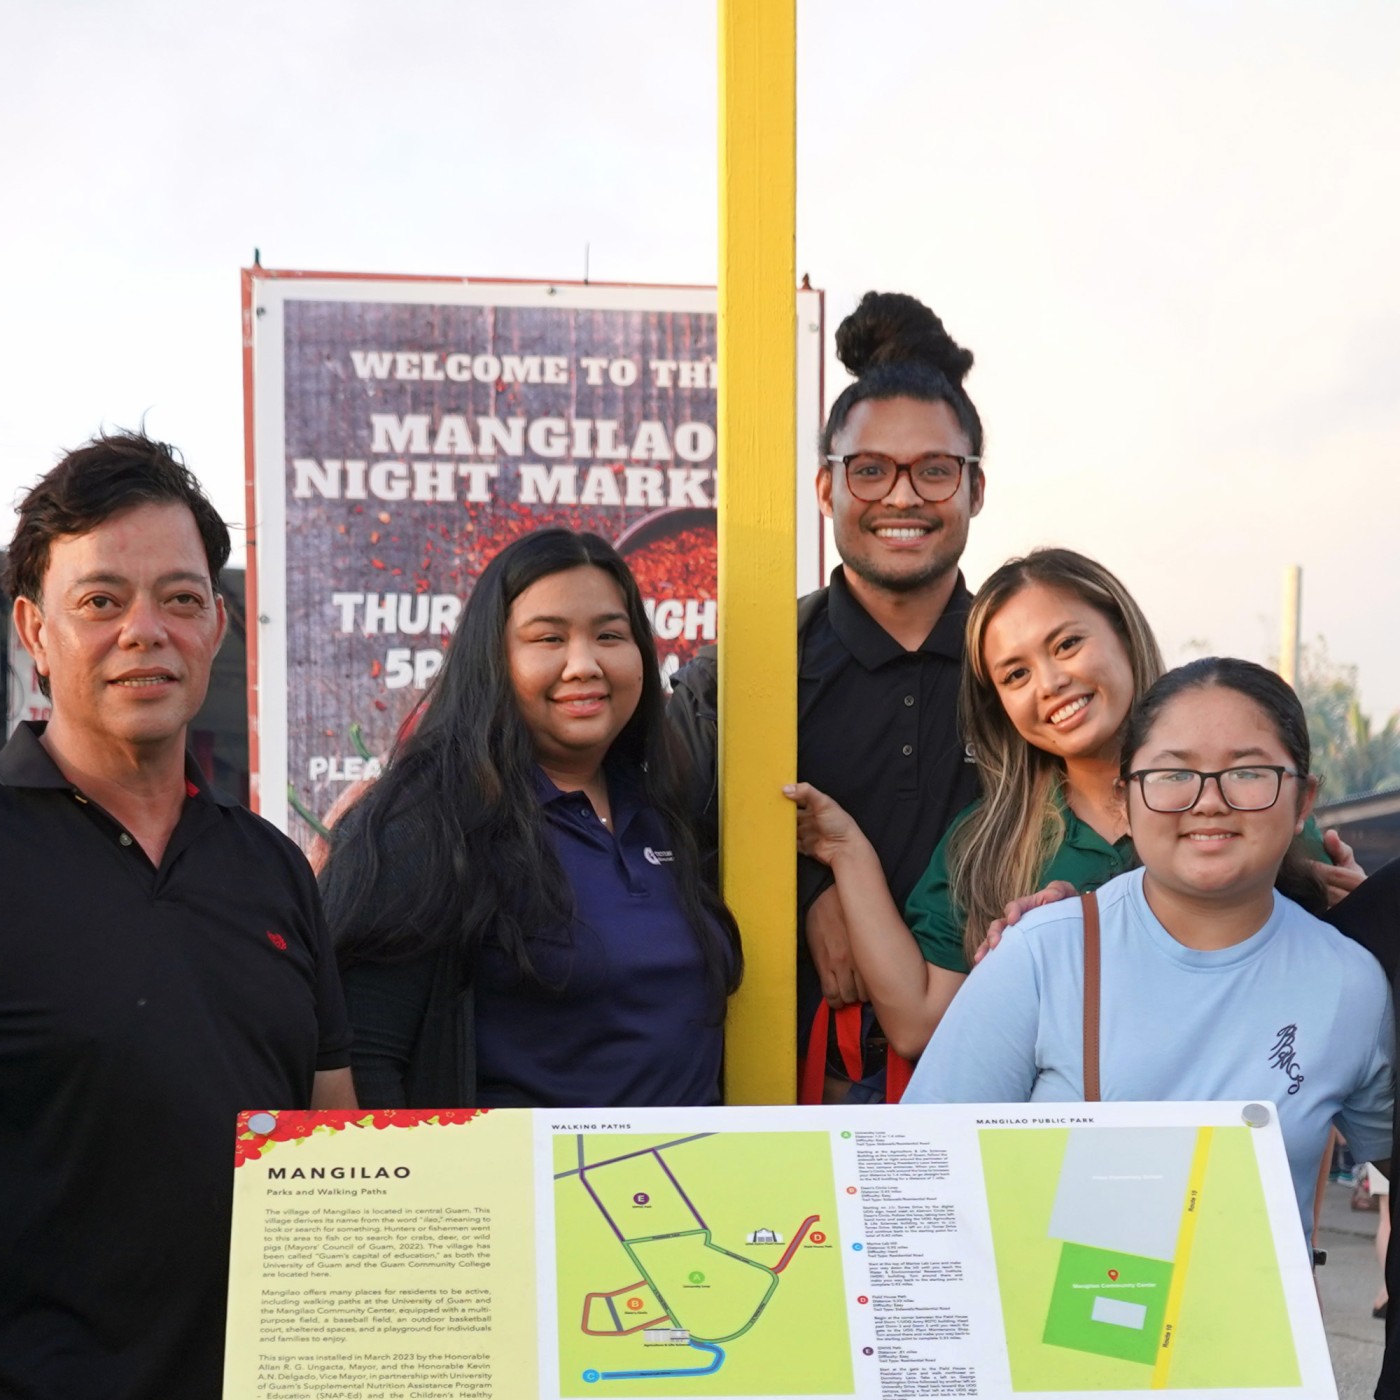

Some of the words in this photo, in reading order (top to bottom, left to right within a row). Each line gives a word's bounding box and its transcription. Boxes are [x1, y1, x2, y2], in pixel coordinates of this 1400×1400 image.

[351, 351, 569, 384] WELCOME
[581, 357, 638, 387] TO
[650, 359, 717, 389] TH
[370, 413, 717, 462] MANGILAO
[293, 459, 499, 502] NIGHT
[518, 463, 718, 509] MARK
[332, 592, 463, 636] THUR
[384, 648, 445, 690] 5P
[309, 756, 382, 781] PLEA
[268, 1166, 411, 1180] MANGILAO
[317, 1189, 358, 1197] Walking
[283, 1209, 310, 1217] village
[323, 1208, 361, 1217] Mangilao
[263, 1262, 303, 1270] University
[408, 1261, 456, 1270] Community
[458, 1261, 491, 1269] College
[261, 1290, 301, 1298] Mangilao
[355, 1289, 382, 1297] places
[278, 1355, 296, 1363] sign
[588, 1372, 594, 1380] C
[303, 1383, 365, 1391] Supplemental
[455, 1382, 493, 1390] Program
[316, 1392, 362, 1400] (SNAP-Ed)
[459, 1392, 493, 1400] Healthy
